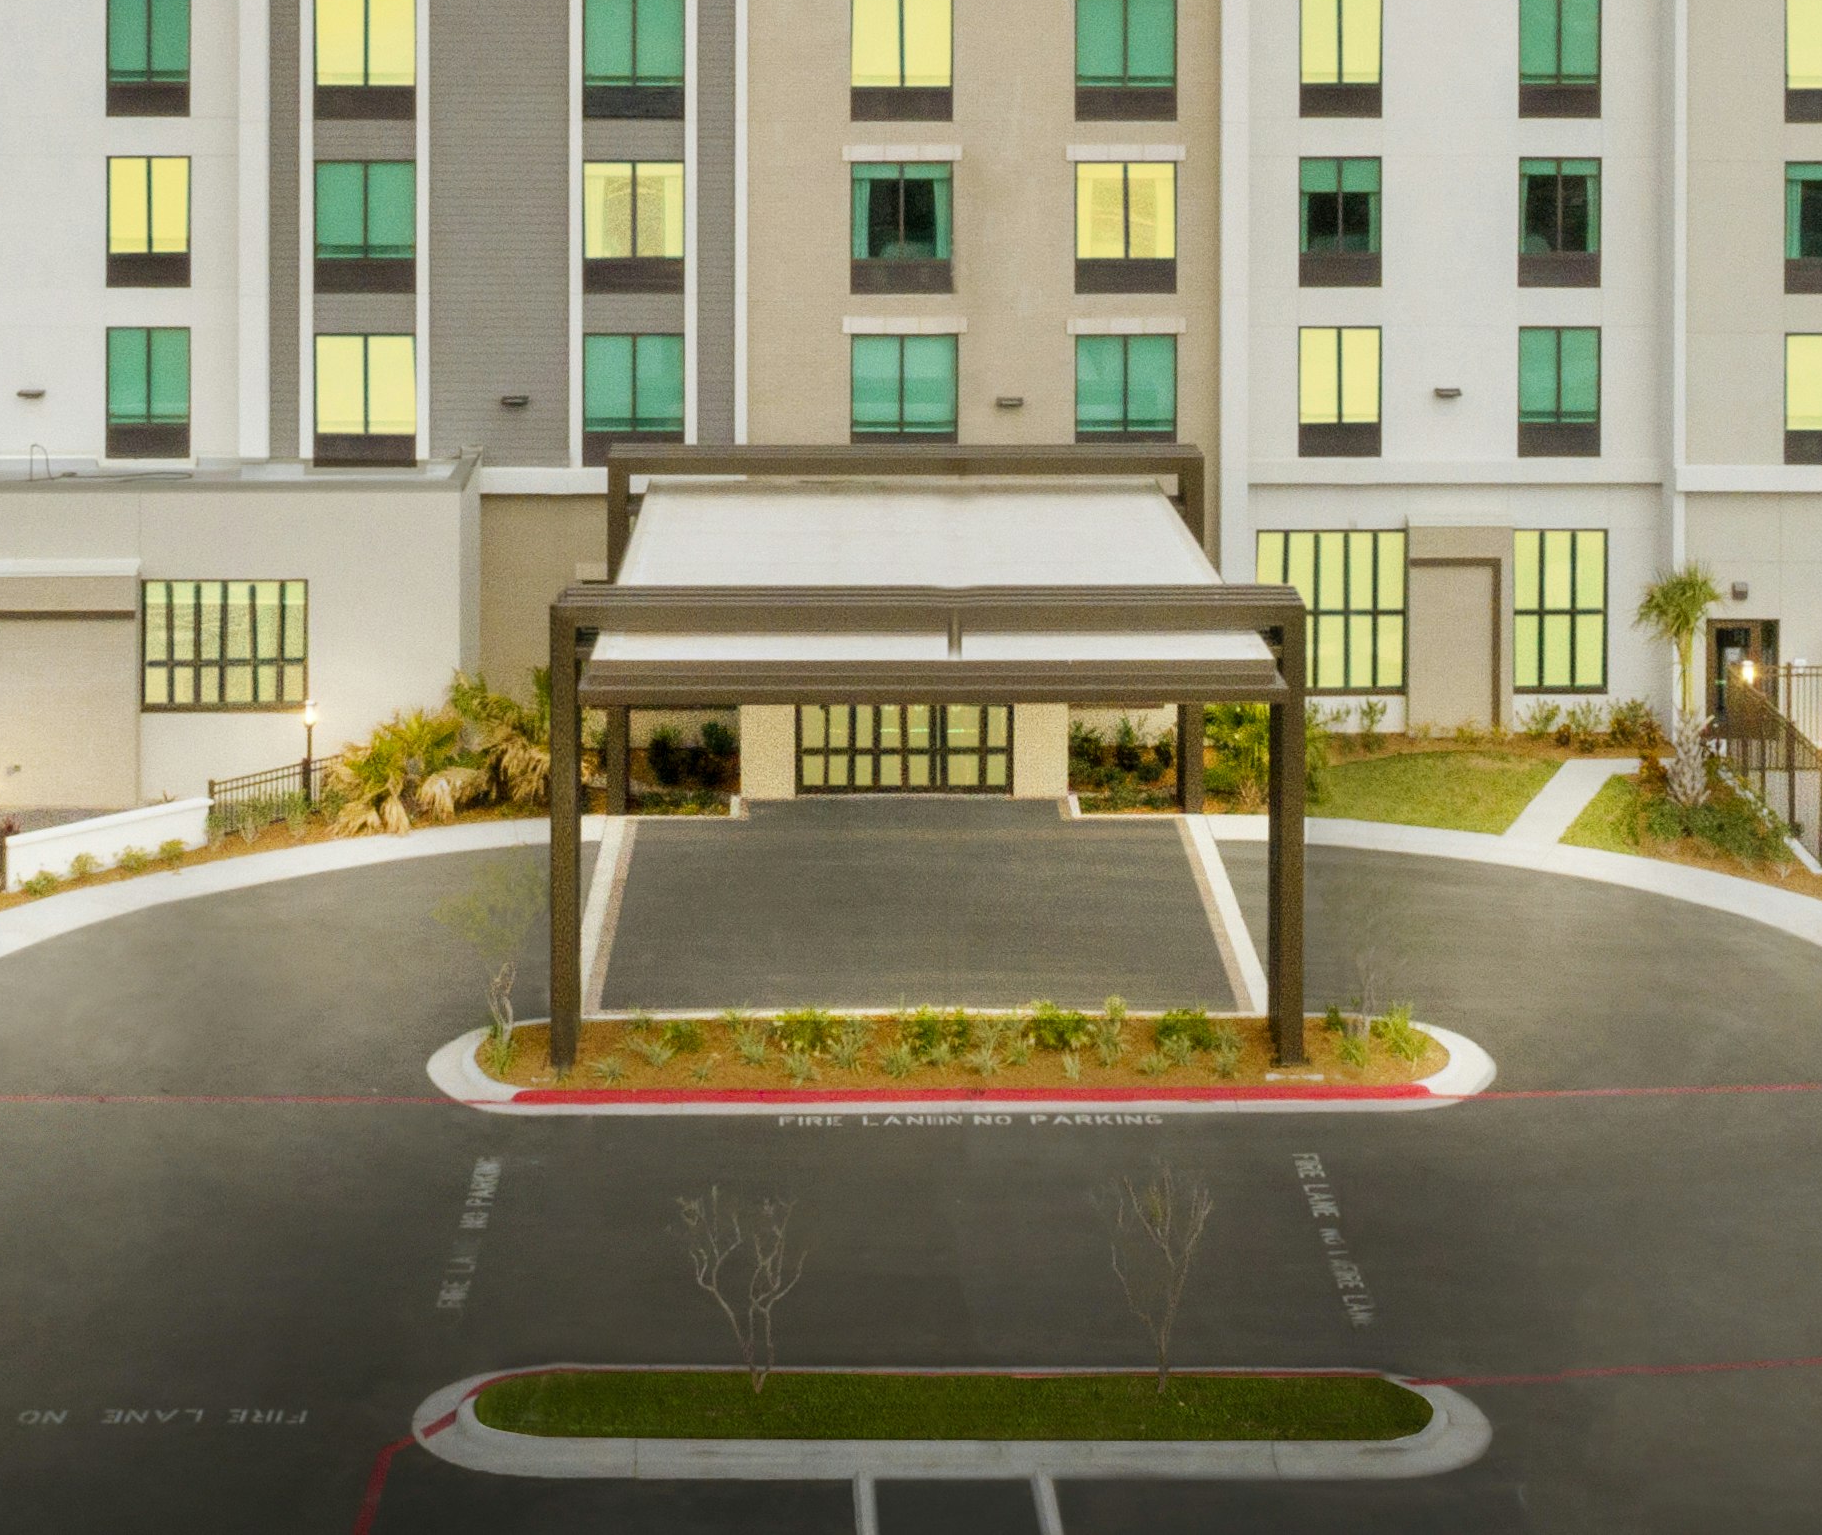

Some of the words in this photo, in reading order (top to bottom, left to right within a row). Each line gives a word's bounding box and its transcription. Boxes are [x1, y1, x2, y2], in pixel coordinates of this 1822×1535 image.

[778, 1114, 843, 1128] FIRE
[973, 1114, 1012, 1126] NO
[1030, 1113, 1164, 1126] PARKING
[1292, 1152, 1326, 1179] FIRE
[1303, 1183, 1340, 1218] LANE
[18, 1409, 68, 1425] NO
[101, 1408, 204, 1424] LANE
[228, 1409, 308, 1424] FIRE
